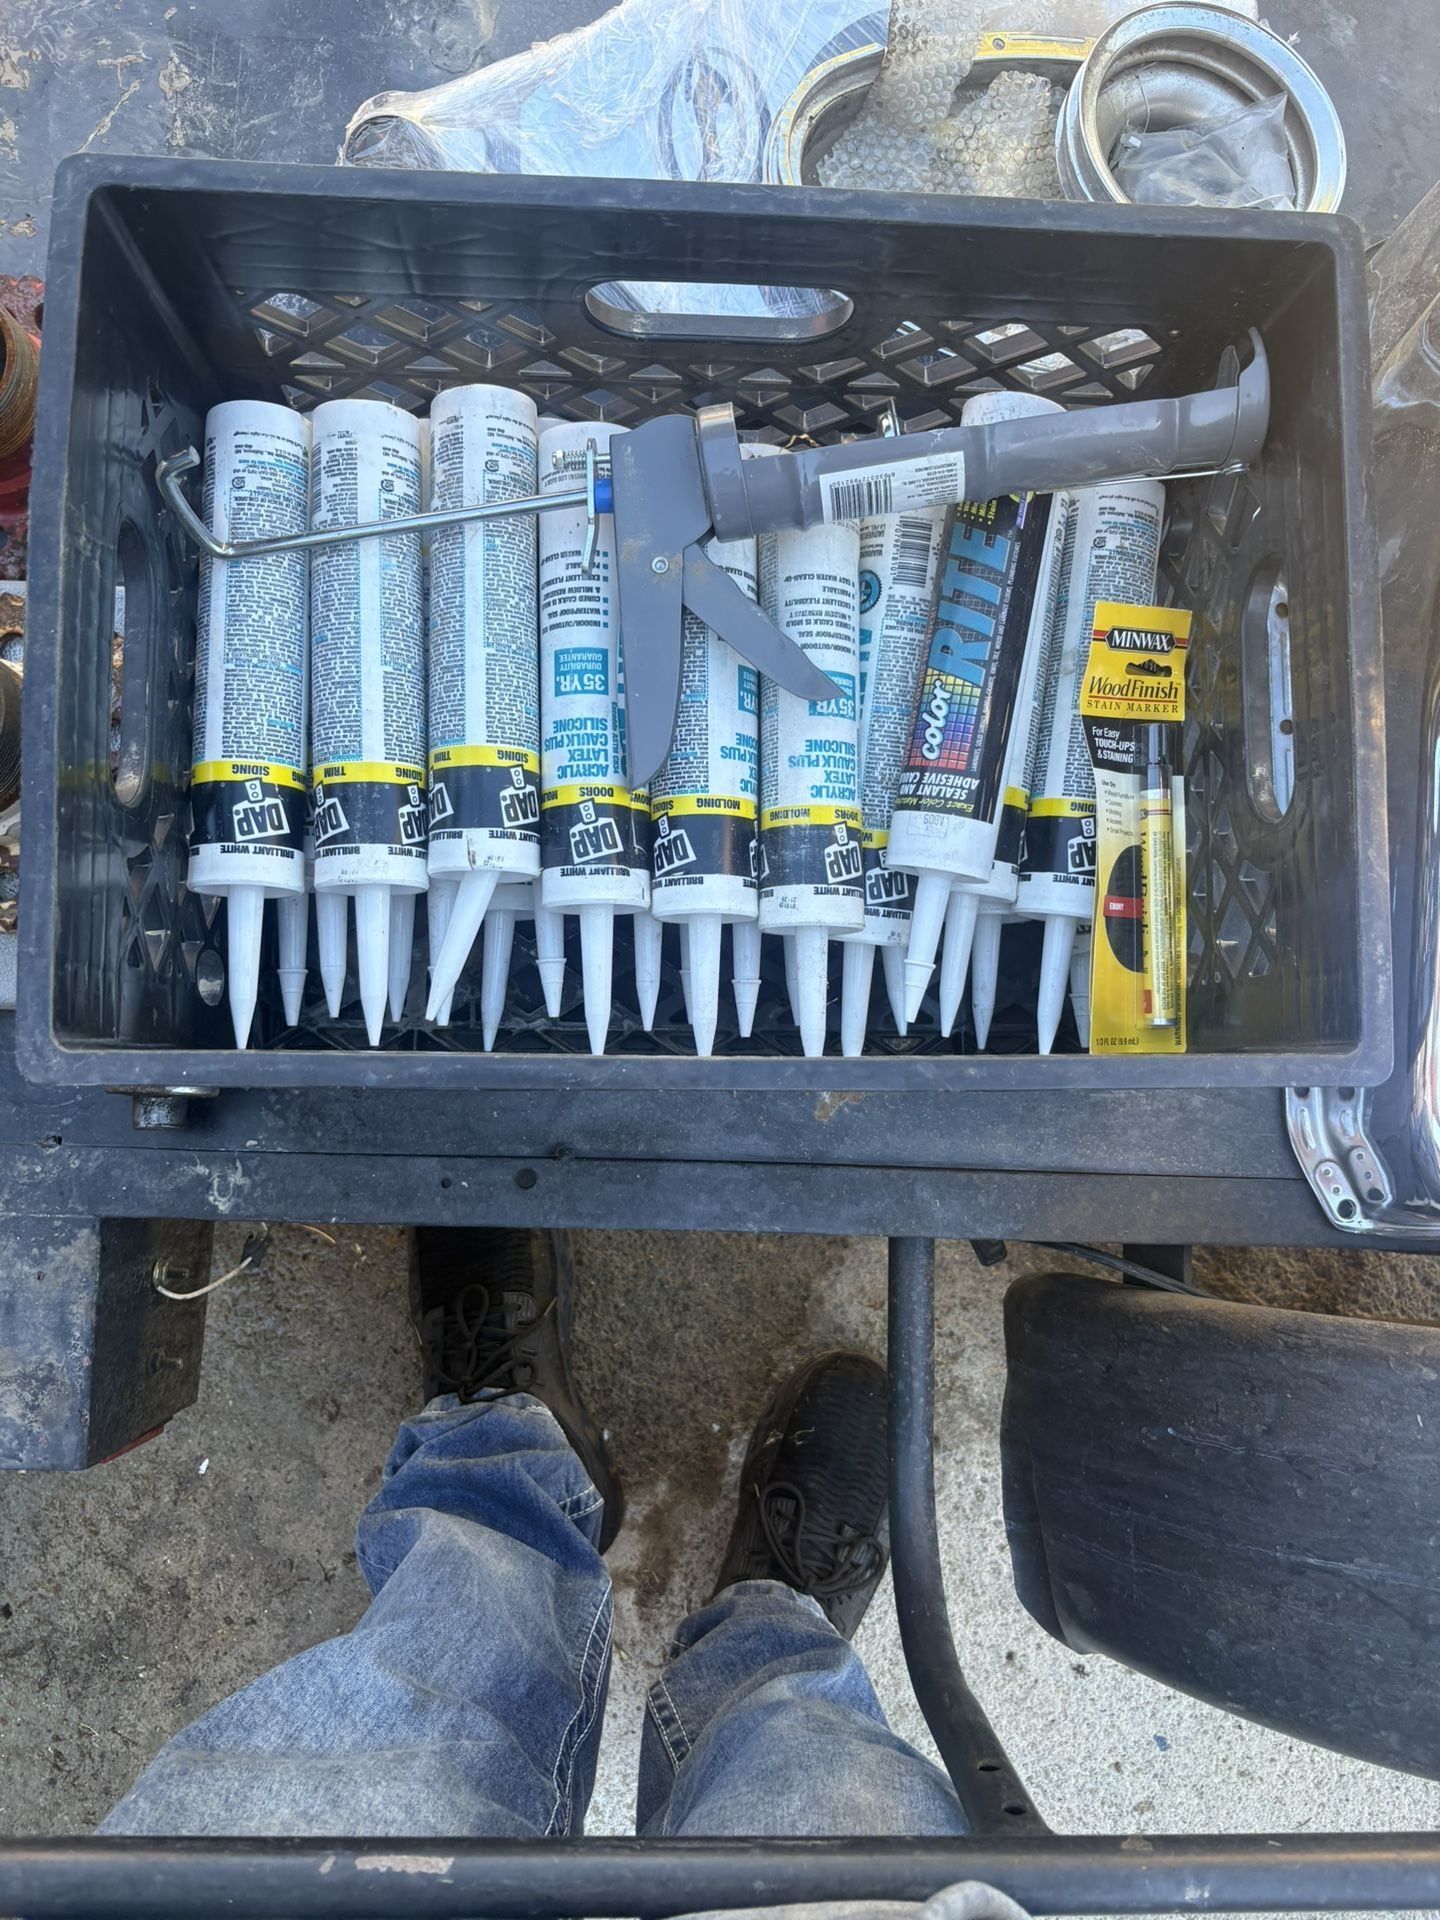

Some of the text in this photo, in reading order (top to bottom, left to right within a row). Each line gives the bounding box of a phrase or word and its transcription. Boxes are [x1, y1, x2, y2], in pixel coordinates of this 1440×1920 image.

[565, 562, 600, 570] PAABLE
[565, 574, 601, 583] EXLLENT
[784, 574, 815, 582] CLEAN-UP
[816, 573, 838, 583] WATER
[567, 586, 594, 595] MILDEW
[784, 597, 851, 609] EXCELLENT FLEXIBILITY
[926, 521, 1011, 689] RITE
[559, 607, 601, 617] WATERPROOF
[785, 619, 804, 628] MOLD
[804, 619, 812, 627] IS
[813, 618, 834, 627] CAULK
[797, 630, 852, 641] WATERPROOF SEAL
[1111, 630, 1172, 652] MINWAX
[559, 652, 603, 662] GUARANTEE
[559, 661, 602, 672] DURABILITY
[1087, 700, 1178, 714] STAIN MARKER
[552, 717, 608, 734] SILICONE
[921, 678, 951, 761] color
[1092, 726, 1121, 740] For Easy
[543, 733, 608, 752] CAULK PLUS
[735, 733, 757, 750] CONE
[804, 739, 856, 756] SILICONE
[1094, 738, 1135, 752] TOUCH-UPS
[433, 750, 451, 763] TRIM
[497, 750, 528, 763] SIDING
[567, 748, 608, 762] LATEX
[720, 745, 747, 761] PLUS
[1097, 750, 1134, 763] & STAINING
[788, 754, 856, 771] CAULK PLUS
[232, 763, 270, 776] SIDING
[323, 765, 346, 778] TRIM
[395, 767, 423, 782] SIDING
[557, 763, 609, 779] ACRYLIC
[824, 770, 856, 786] LATEX
[900, 772, 980, 790] ADHESIVE CAU
[578, 787, 614, 798] DOORS
[810, 785, 857, 801] ACRYLIC
[916, 784, 969, 800] SEALANT
[504, 790, 537, 823] DAP
[652, 798, 741, 814] MOLDING SIDING
[919, 797, 975, 813] Exact Color
[236, 802, 285, 836] DAP
[769, 809, 858, 821] DOORS MOLDING
[488, 830, 517, 842] WHITE
[572, 822, 619, 858] DAP
[220, 844, 295, 859] BRILLIANT WHITE
[322, 845, 360, 858] BRILLIANT
[387, 846, 413, 858] WHITE
[1069, 840, 1096, 868] AP
[827, 845, 861, 878] DAP
[559, 866, 630, 877] BRILLIANT WHITE
[664, 875, 704, 887] BRILLIANT
[742, 878, 757, 889] HITE
[869, 871, 906, 901] DAP
[1052, 874, 1080, 886] WHITE
[813, 886, 840, 896] WHITE
[1109, 901, 1125, 911] EBONY
[864, 907, 911, 920] BRILLIANT WHI
